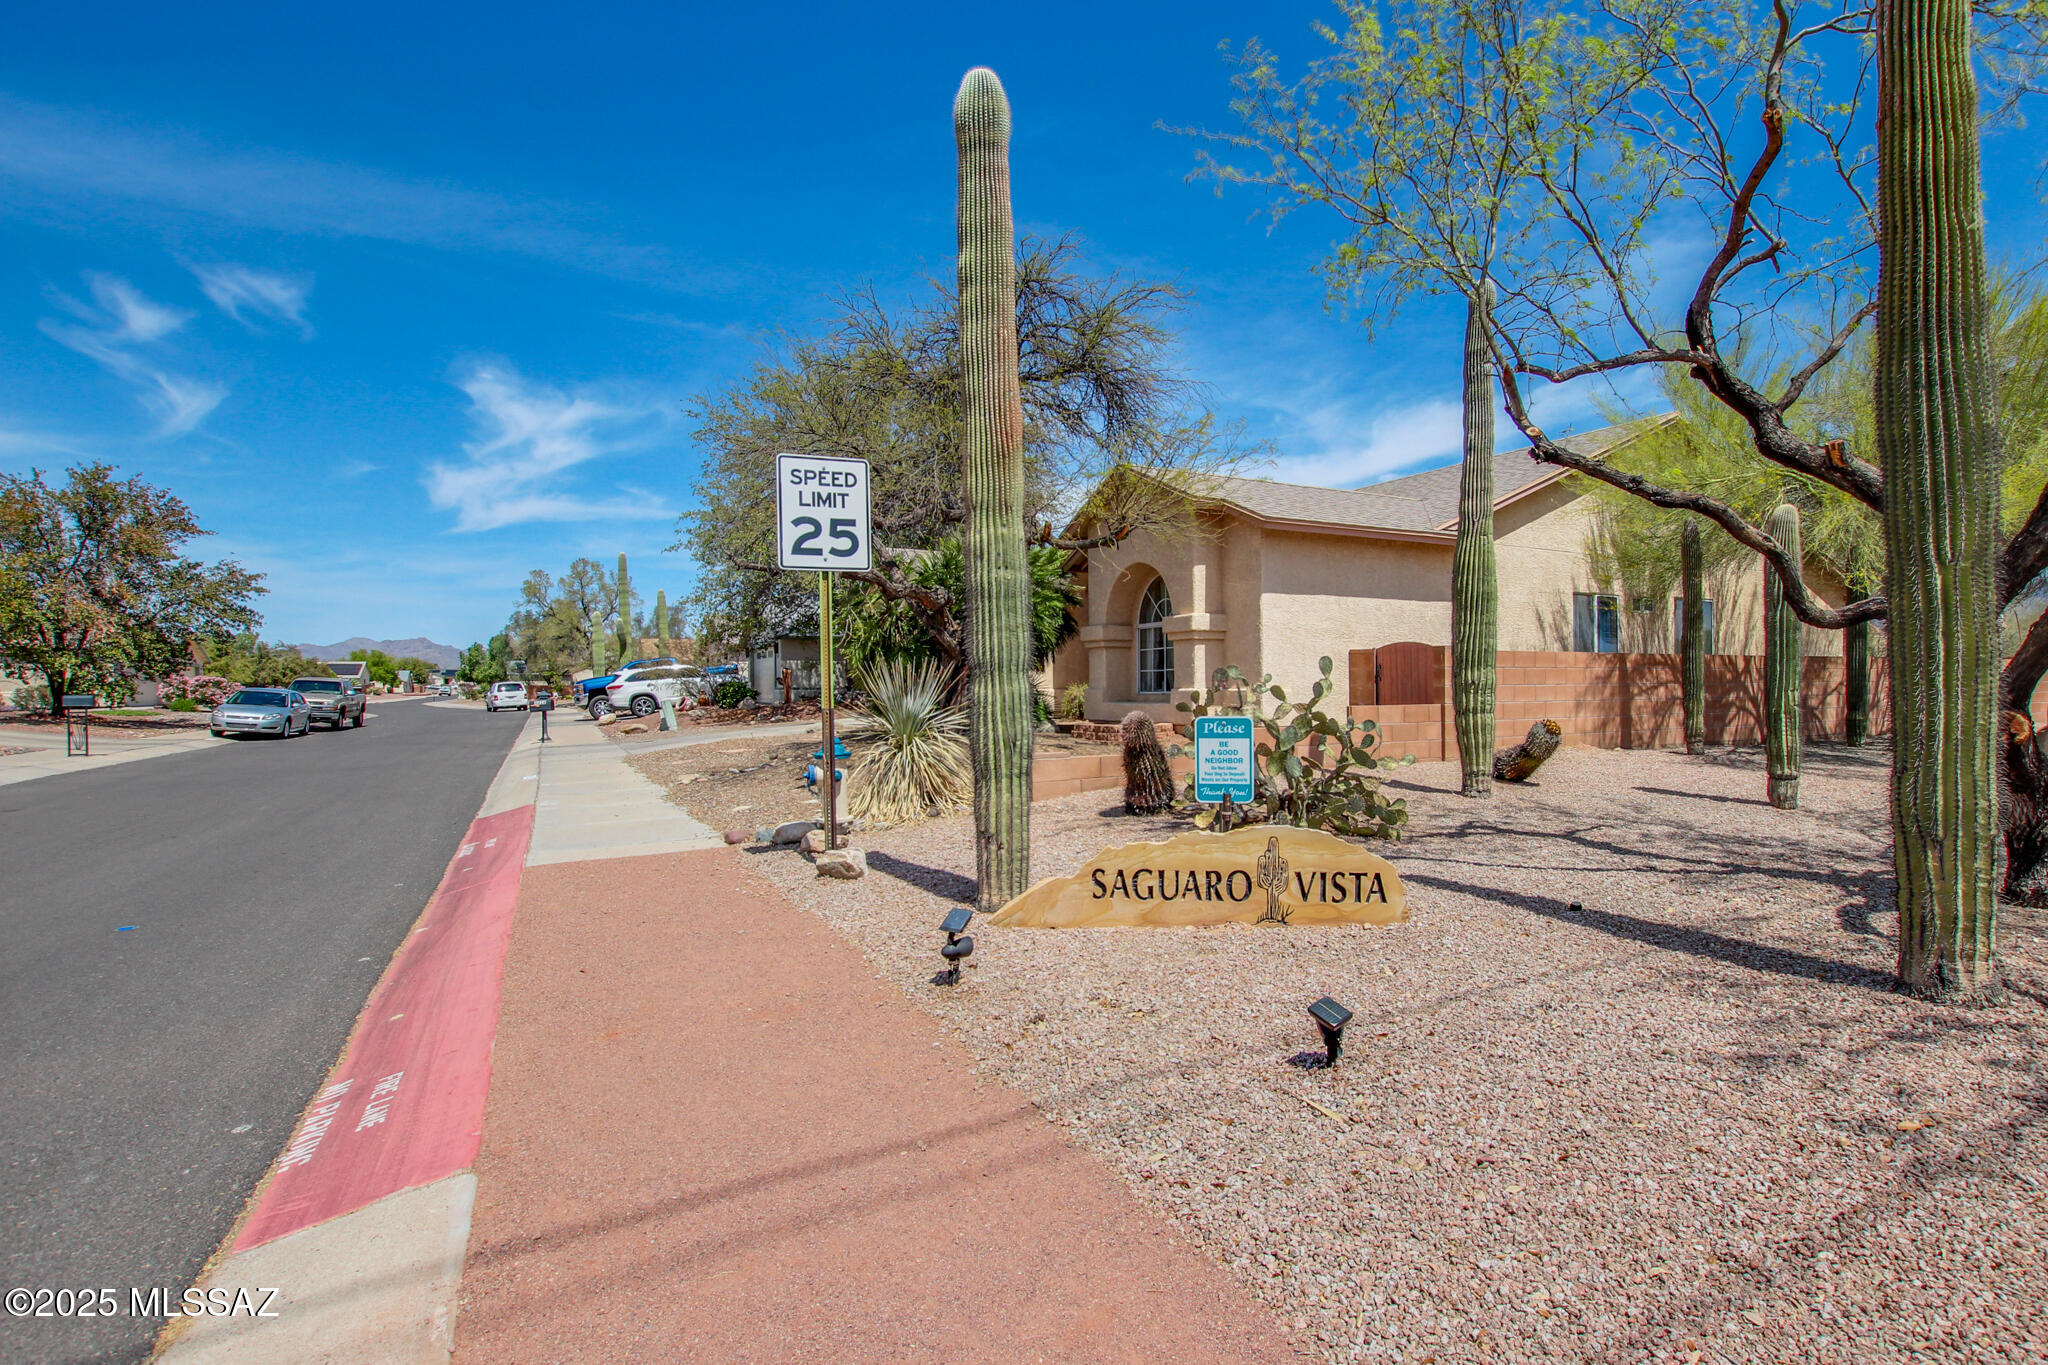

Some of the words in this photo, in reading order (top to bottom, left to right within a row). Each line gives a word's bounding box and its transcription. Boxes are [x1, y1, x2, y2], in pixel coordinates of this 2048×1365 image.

[790, 468, 858, 488] SPEED
[799, 490, 849, 508] LIMIT
[790, 516, 860, 557] 25
[1204, 721, 1245, 734] Please
[1200, 787, 1226, 796] Thank
[1091, 868, 1253, 902] SAGUARO
[1295, 871, 1388, 904] VISTA
